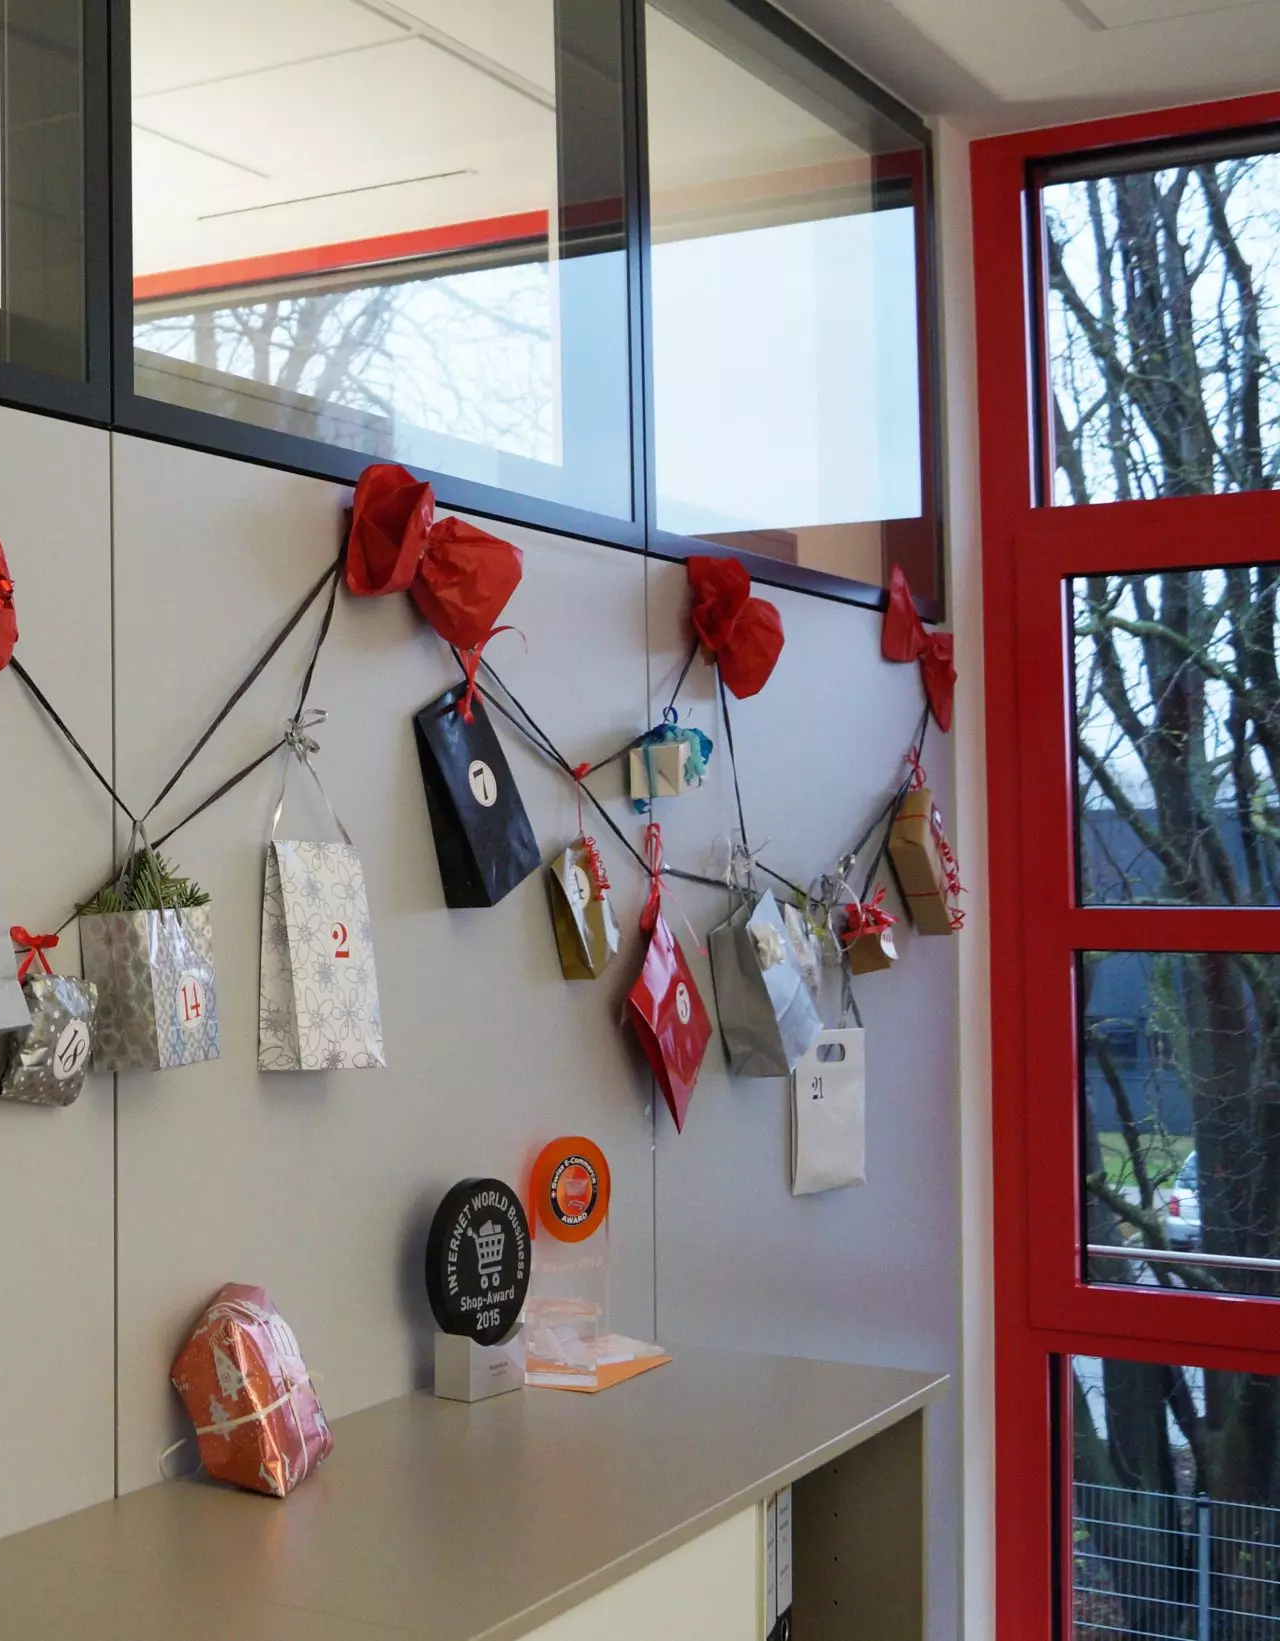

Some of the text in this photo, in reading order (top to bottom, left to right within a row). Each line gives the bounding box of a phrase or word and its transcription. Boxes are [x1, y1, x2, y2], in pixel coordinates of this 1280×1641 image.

[472, 767, 489, 801] 7
[330, 922, 350, 958] 2
[181, 981, 204, 1022] 14
[678, 987, 688, 1018] 5
[57, 1028, 86, 1073] 18
[811, 1076, 825, 1100] 21
[551, 1156, 597, 1189] Swiss E-Commerce
[561, 1212, 588, 1224] AWARD
[447, 1190, 525, 1296] INTERNET WORLD Business
[460, 1285, 515, 1312] Shop-Award
[475, 1308, 501, 1331] 2015
